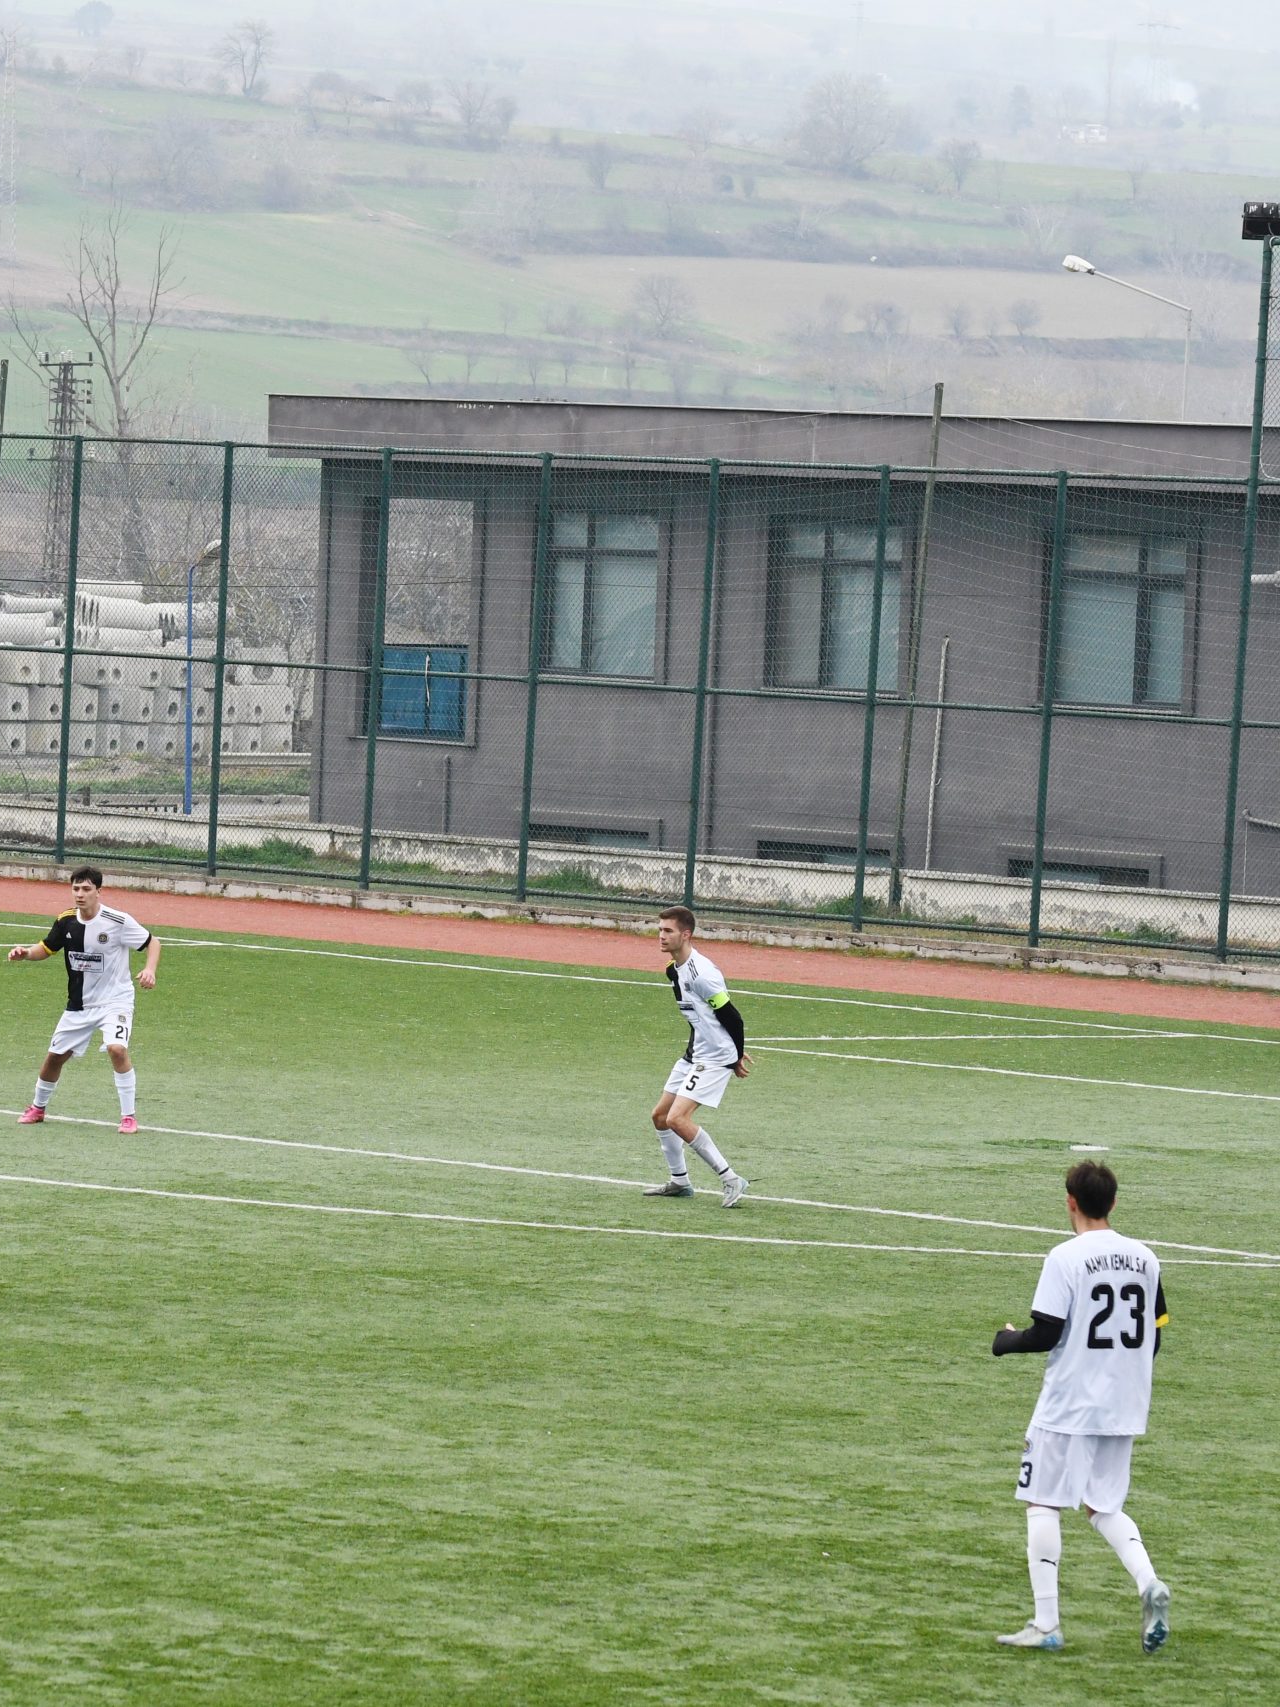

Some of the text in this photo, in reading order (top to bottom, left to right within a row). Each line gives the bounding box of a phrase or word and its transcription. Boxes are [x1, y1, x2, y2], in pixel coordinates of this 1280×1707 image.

[708, 999, 717, 1009] C
[114, 1025, 129, 1041] 21
[685, 1074, 700, 1091] 5
[1087, 1282, 1145, 1349] 23
[1018, 1461, 1032, 1488] 3
